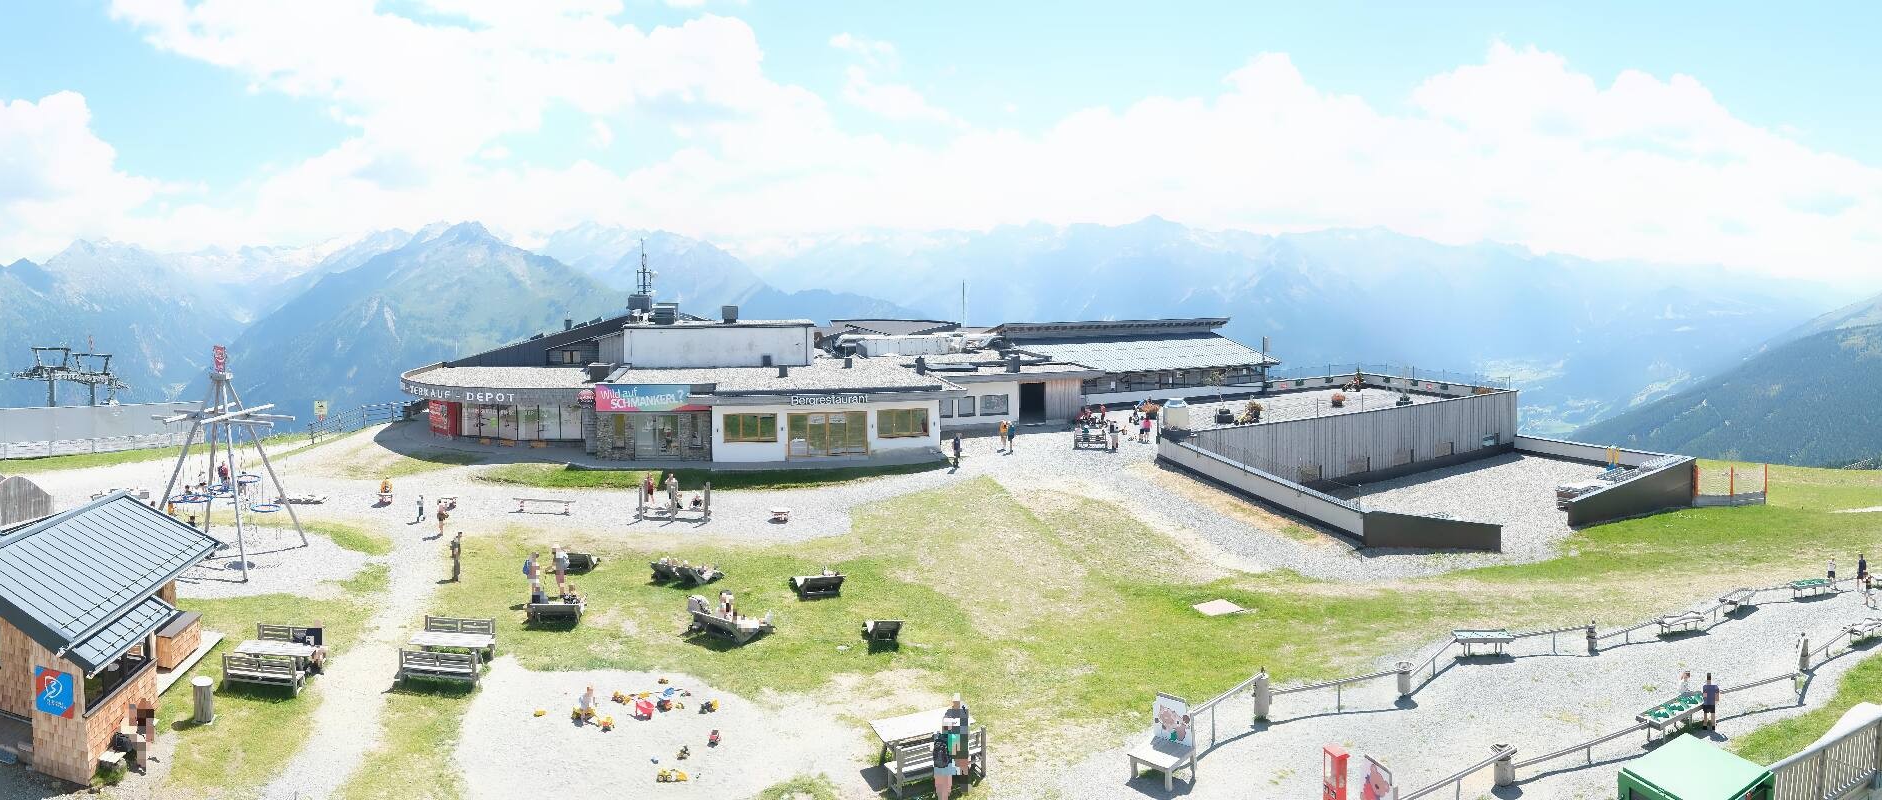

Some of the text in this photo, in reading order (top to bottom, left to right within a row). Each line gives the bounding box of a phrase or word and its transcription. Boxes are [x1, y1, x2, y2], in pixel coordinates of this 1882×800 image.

[466, 392, 515, 402] DEPOT
[600, 388, 621, 400] Wild
[622, 386, 637, 398] auf
[610, 389, 684, 409] SCHMANKERL?
[791, 394, 869, 406] Bergrestaurant
